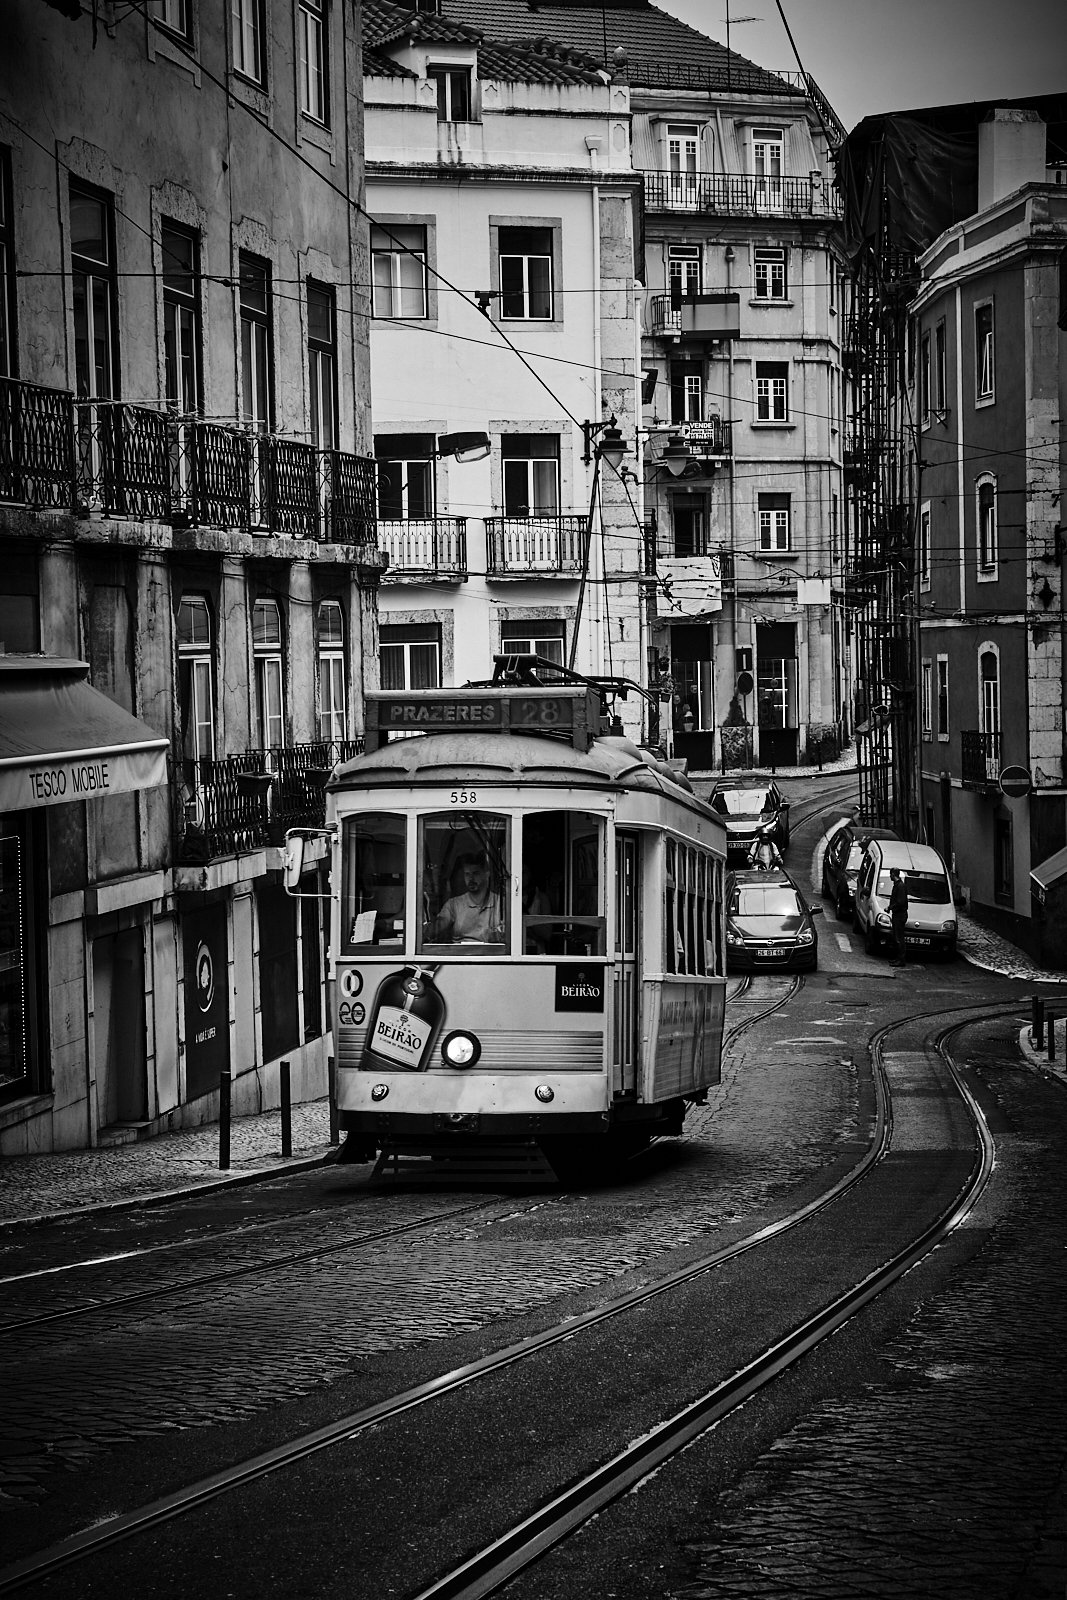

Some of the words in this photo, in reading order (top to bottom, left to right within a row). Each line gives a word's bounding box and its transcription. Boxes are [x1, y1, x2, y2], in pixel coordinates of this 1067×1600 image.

[390, 704, 495, 721] PRAZERES
[521, 699, 559, 723] 28
[29, 769, 67, 799] TESCO
[71, 763, 110, 793] MOBILE
[450, 791, 477, 804] 558
[561, 985, 600, 998] BEIRÃO
[377, 1021, 422, 1050] BEIRÃO
